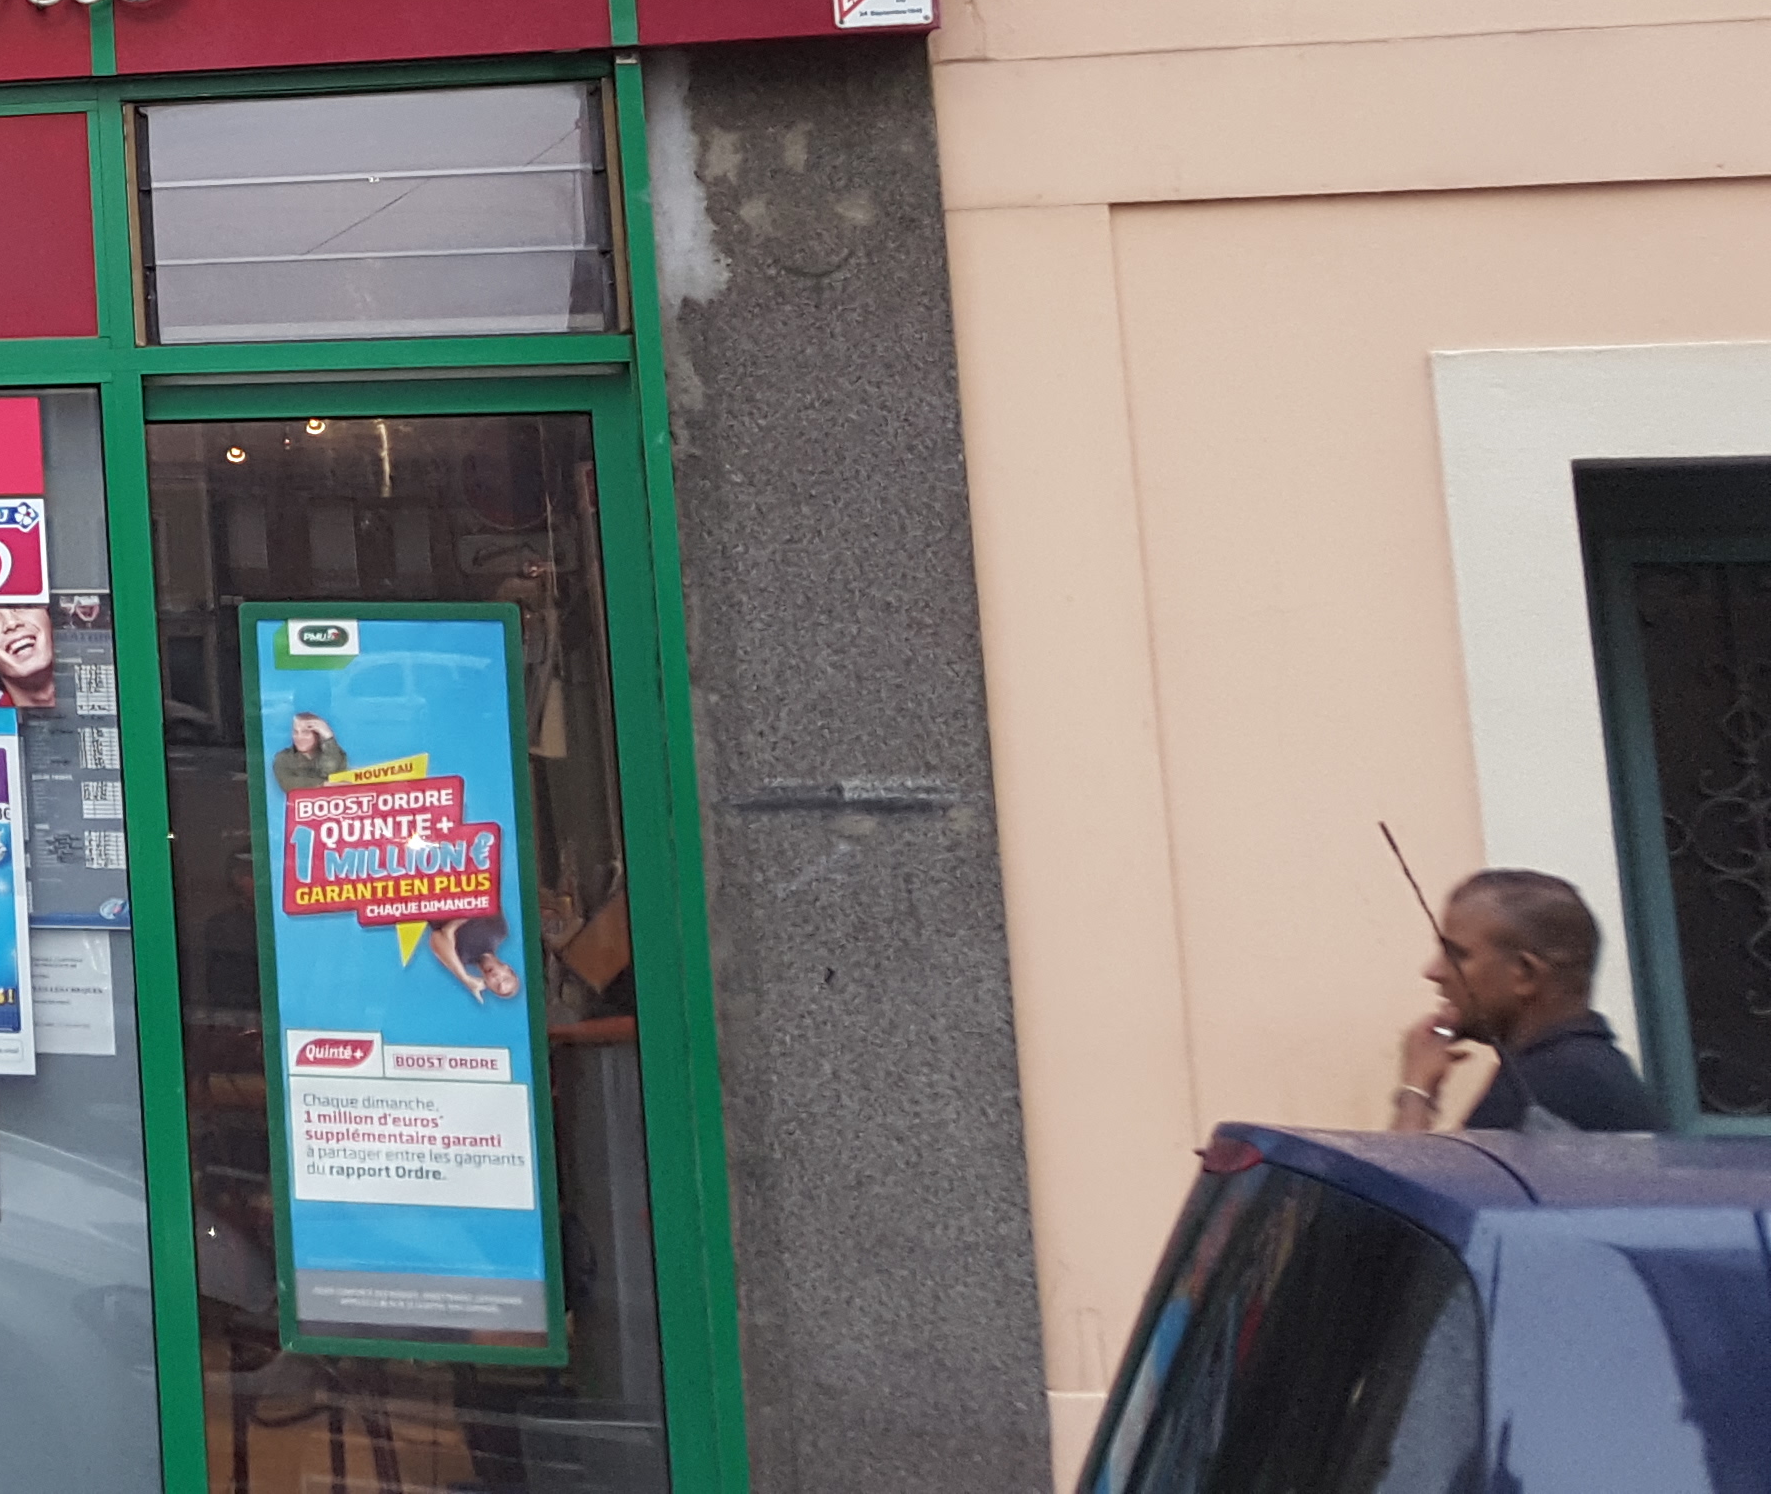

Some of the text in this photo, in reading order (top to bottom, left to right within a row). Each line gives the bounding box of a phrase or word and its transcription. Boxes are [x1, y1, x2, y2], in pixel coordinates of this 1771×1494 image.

[303, 631, 328, 642] PMU
[354, 763, 414, 782] NOUVEAU
[297, 788, 454, 819] BOOST ORDRE
[324, 840, 467, 882] MILLION
[295, 872, 491, 905] GARANTI EN PLUS
[366, 896, 490, 918] CHAQUE DIMANCHE
[395, 1056, 499, 1071] BOOST ORDRE
[303, 1093, 358, 1110] Chaque
[304, 1110, 313, 1124] 1
[317, 1111, 374, 1126] million
[305, 1128, 502, 1150] supplémentaire garanti
[318, 1147, 381, 1164] partager
[385, 1150, 425, 1163] entre
[429, 1151, 451, 1165] les
[454, 1154, 526, 1170] gagnants
[307, 1163, 325, 1175] du
[329, 1165, 391, 1181] rapport
